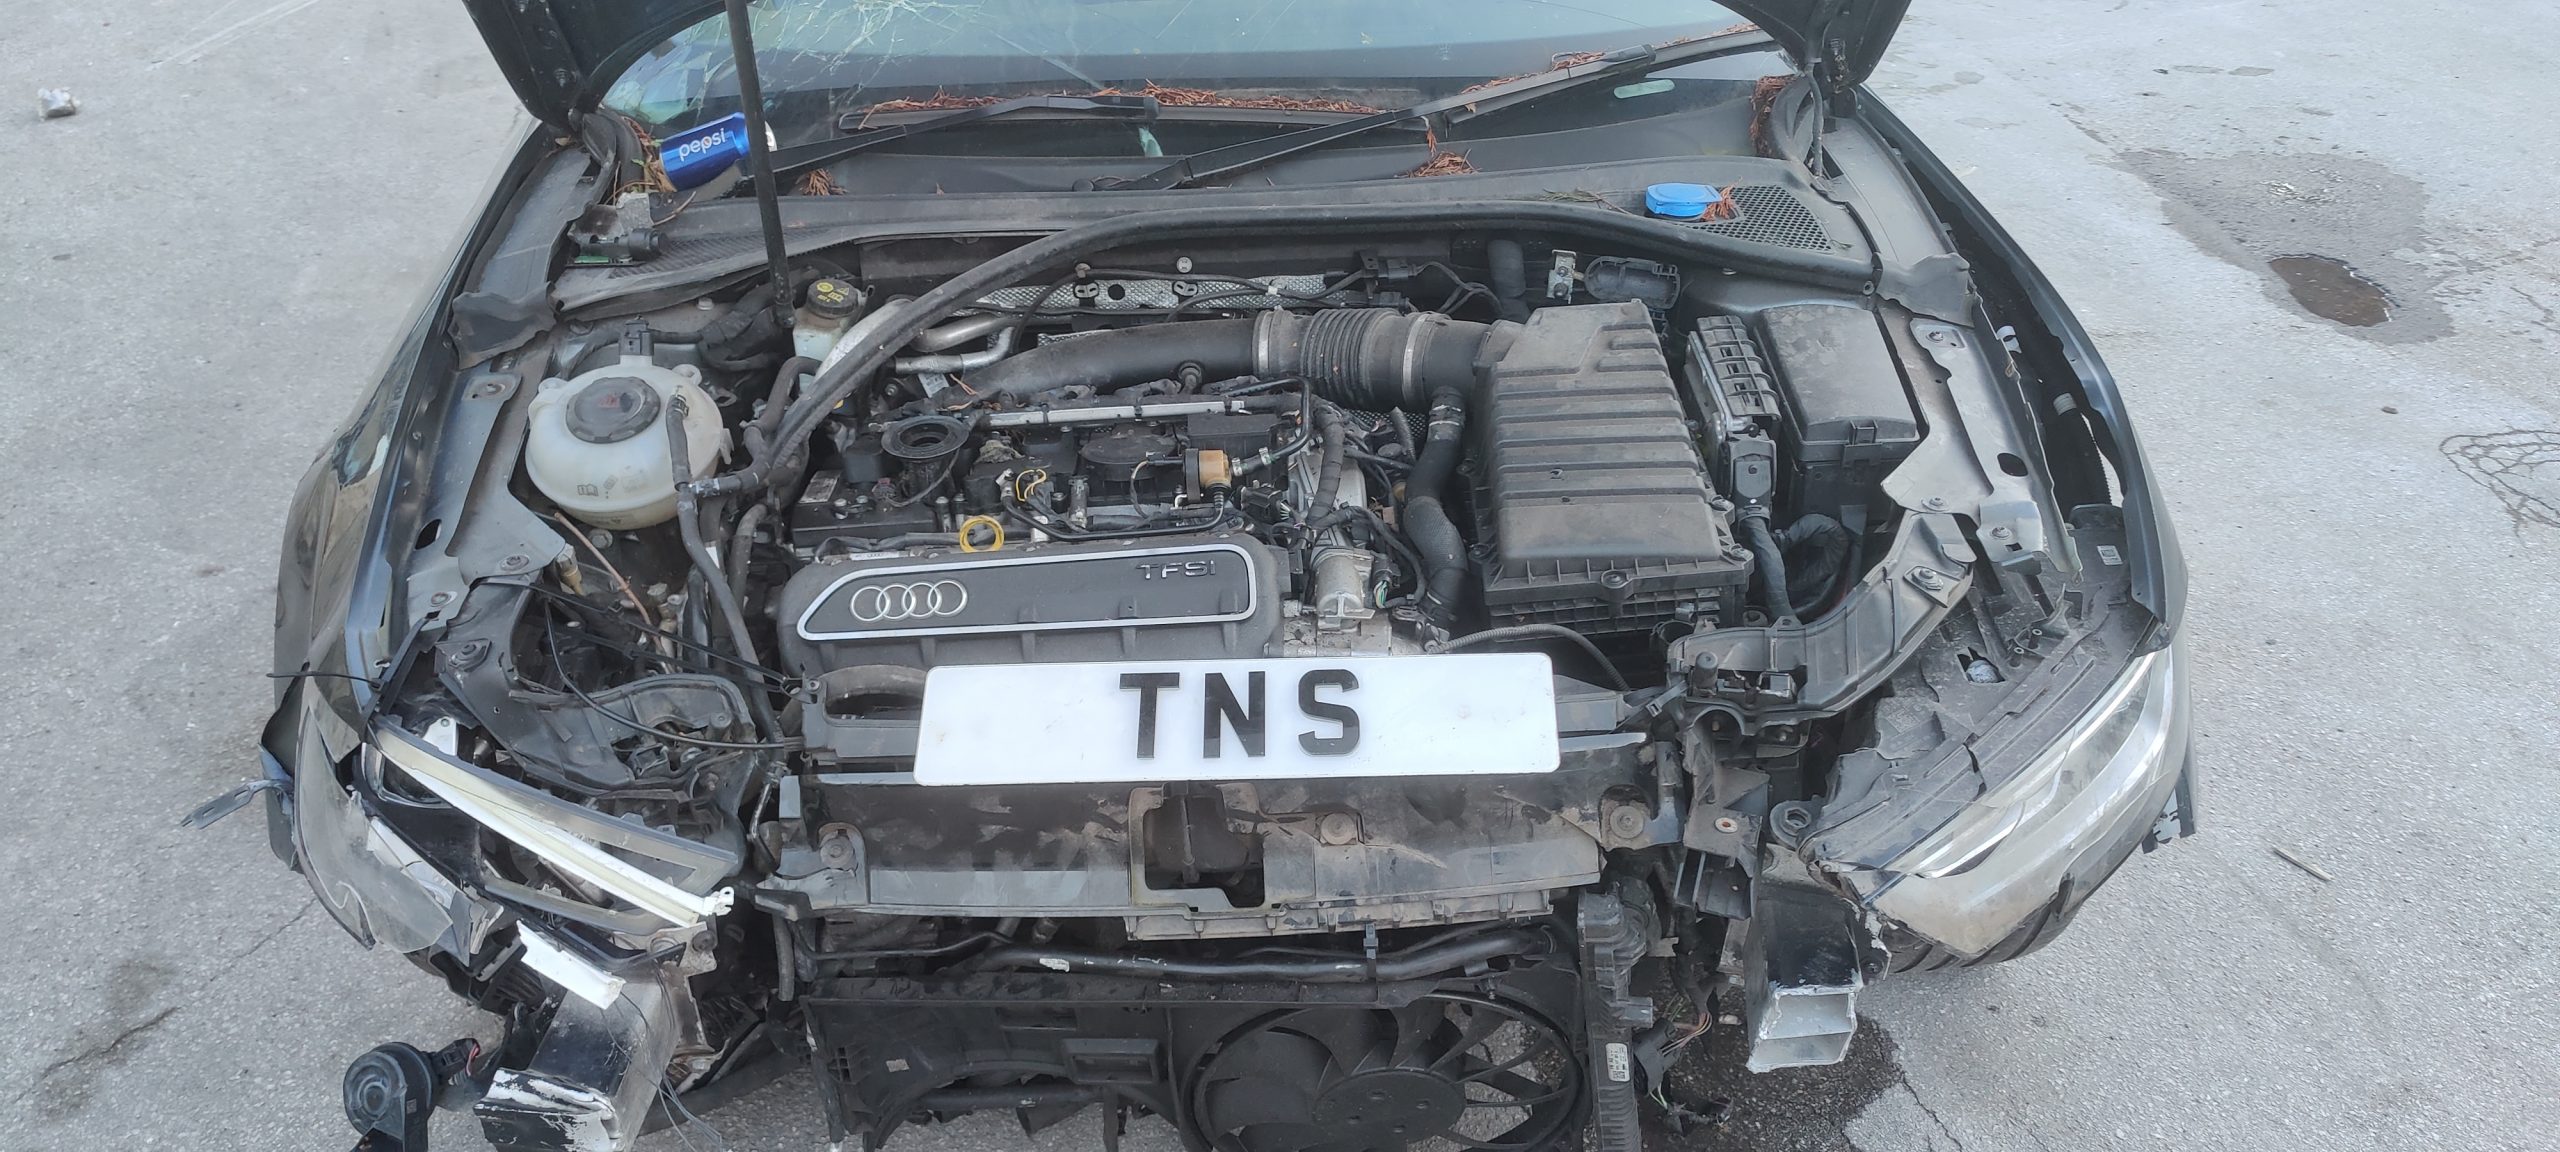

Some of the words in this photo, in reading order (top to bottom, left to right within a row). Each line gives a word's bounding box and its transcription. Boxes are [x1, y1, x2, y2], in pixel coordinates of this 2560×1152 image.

[679, 127, 726, 162] pepsi
[1136, 560, 1216, 580] TFSI
[1119, 668, 1360, 759] TNS
